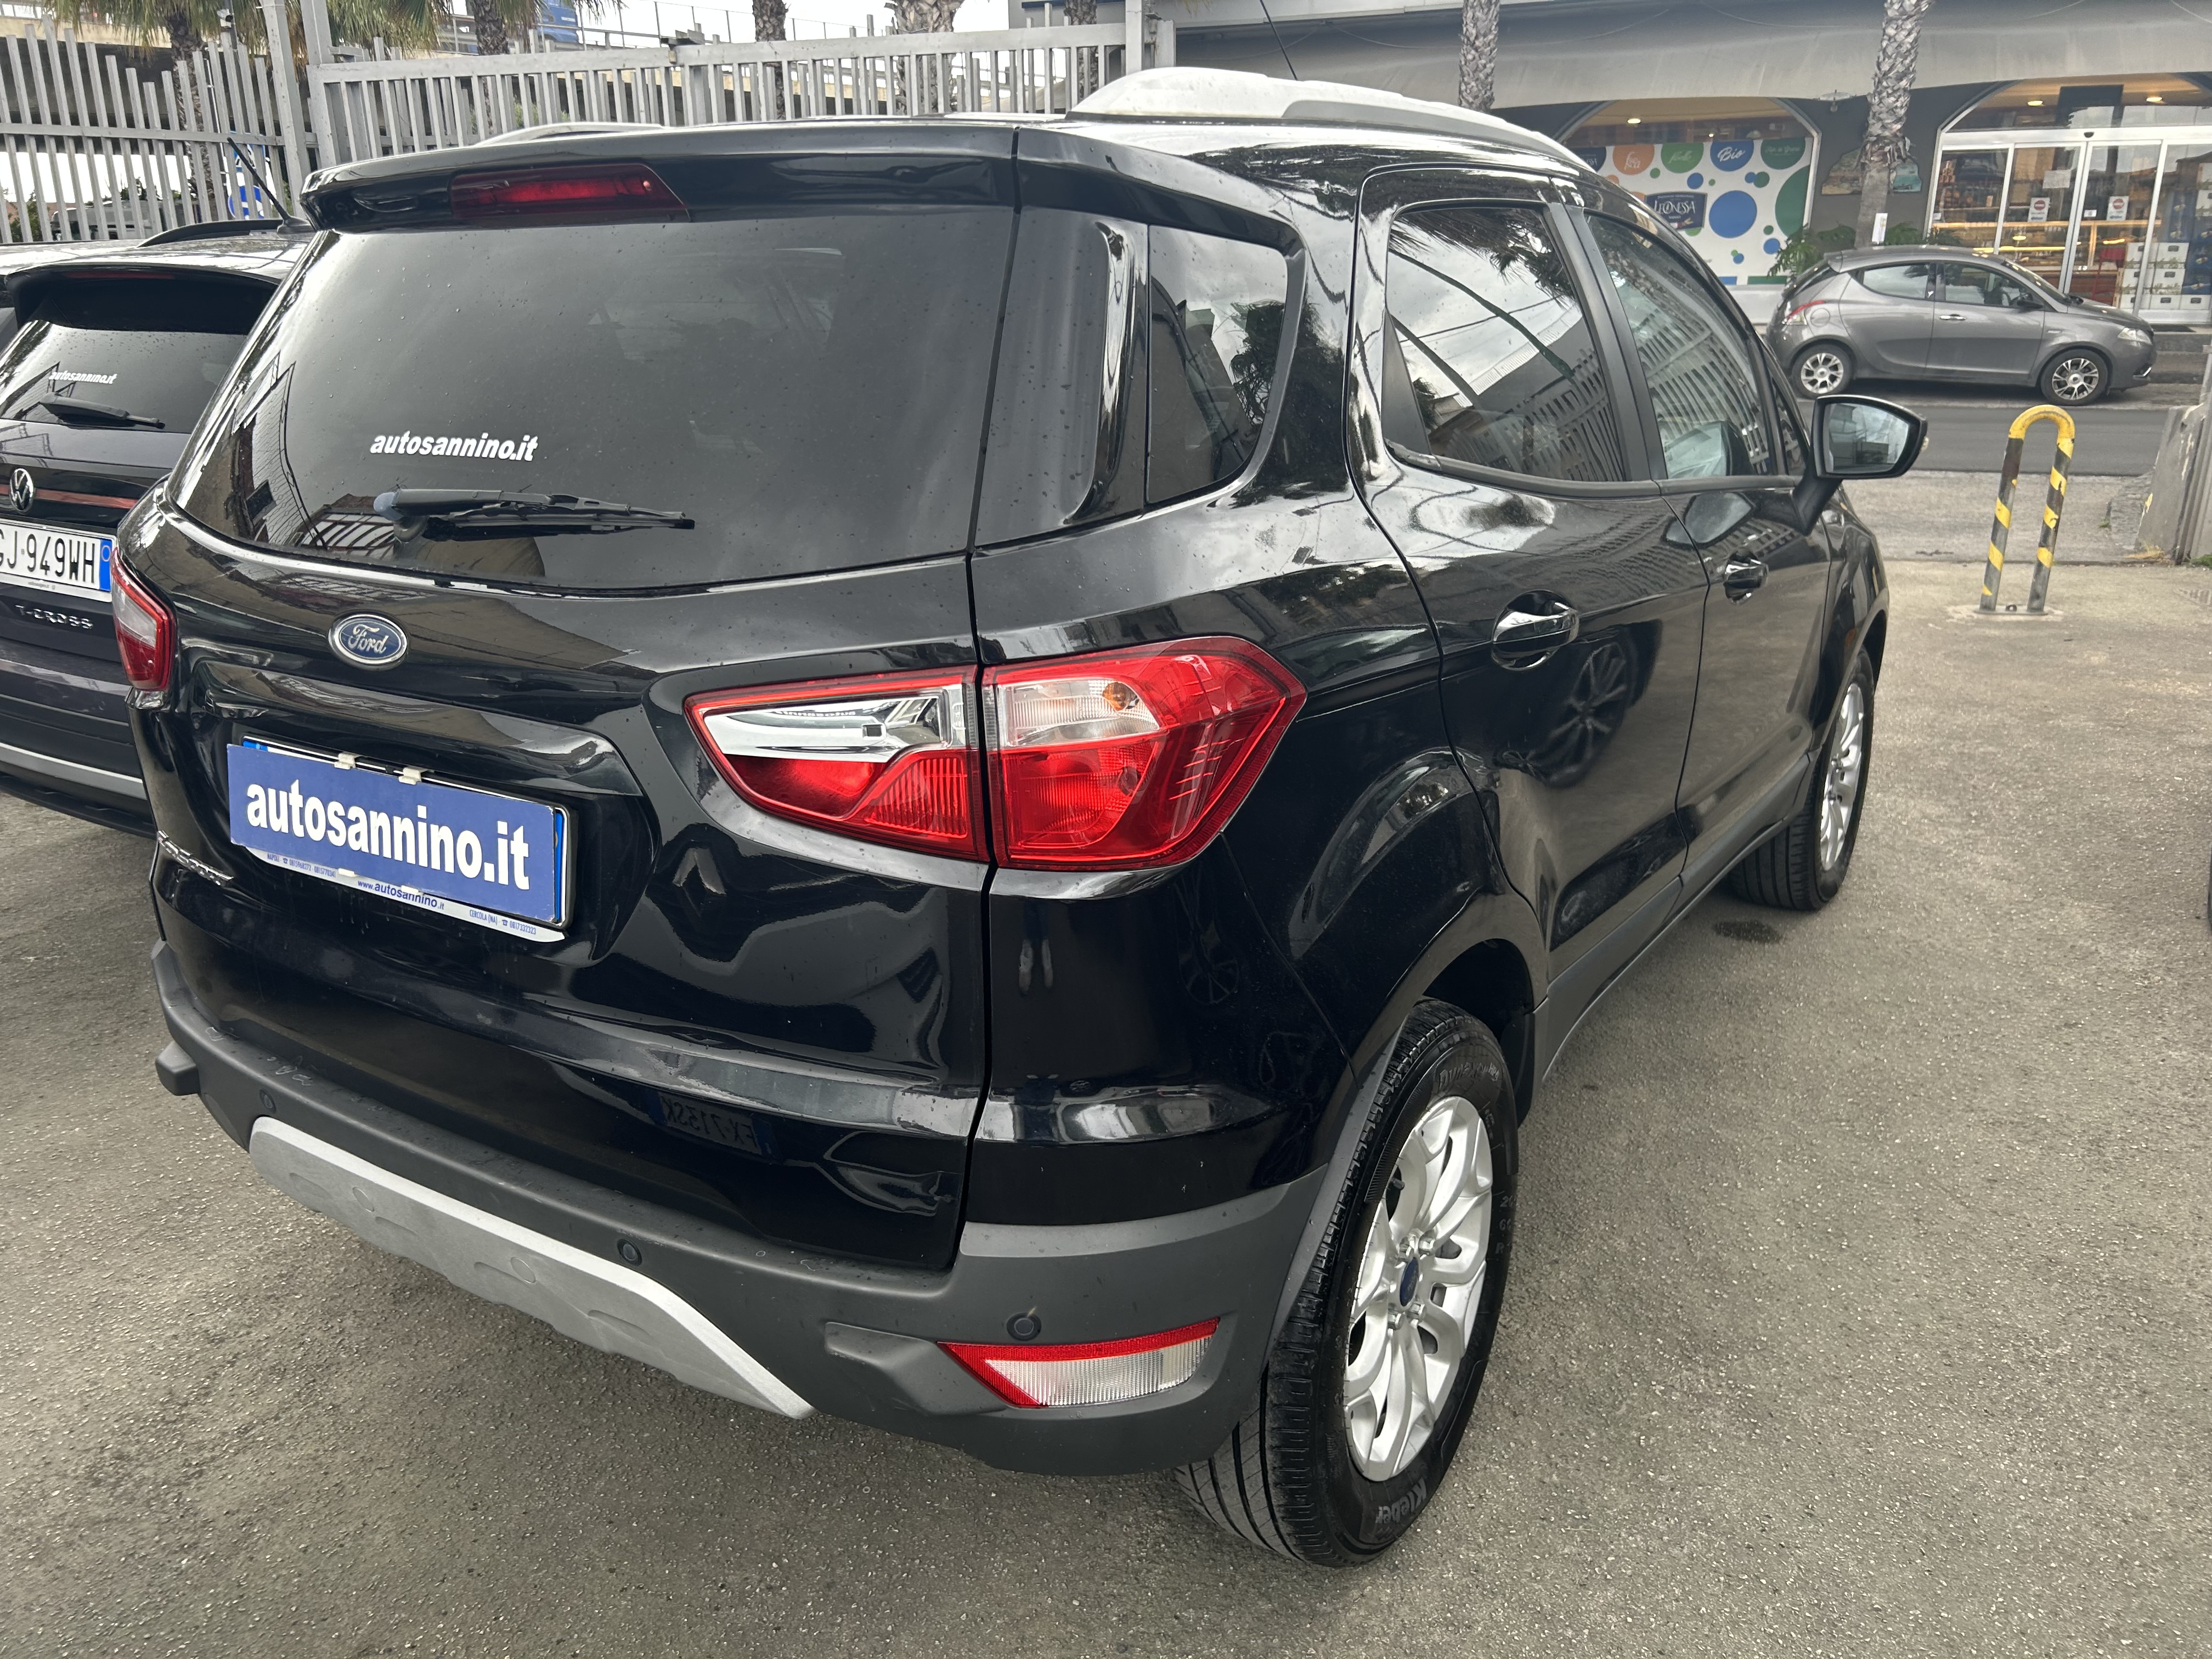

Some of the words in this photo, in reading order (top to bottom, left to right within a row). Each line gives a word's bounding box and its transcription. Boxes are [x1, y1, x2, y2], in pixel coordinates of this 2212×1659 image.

[1717, 146, 1746, 162] Bio
[370, 431, 538, 461] autosannino.it
[15, 605, 93, 629] T-CROSS
[347, 624, 389, 654] Ford
[246, 778, 530, 890] autosannino.it
[267, 853, 280, 863] NAPOLI
[358, 880, 444, 910] www.autosannino.it
[470, 909, 487, 921] CERCOLA
[488, 914, 498, 926] (NA)
[1375, 1477, 1426, 1523] Kleber
